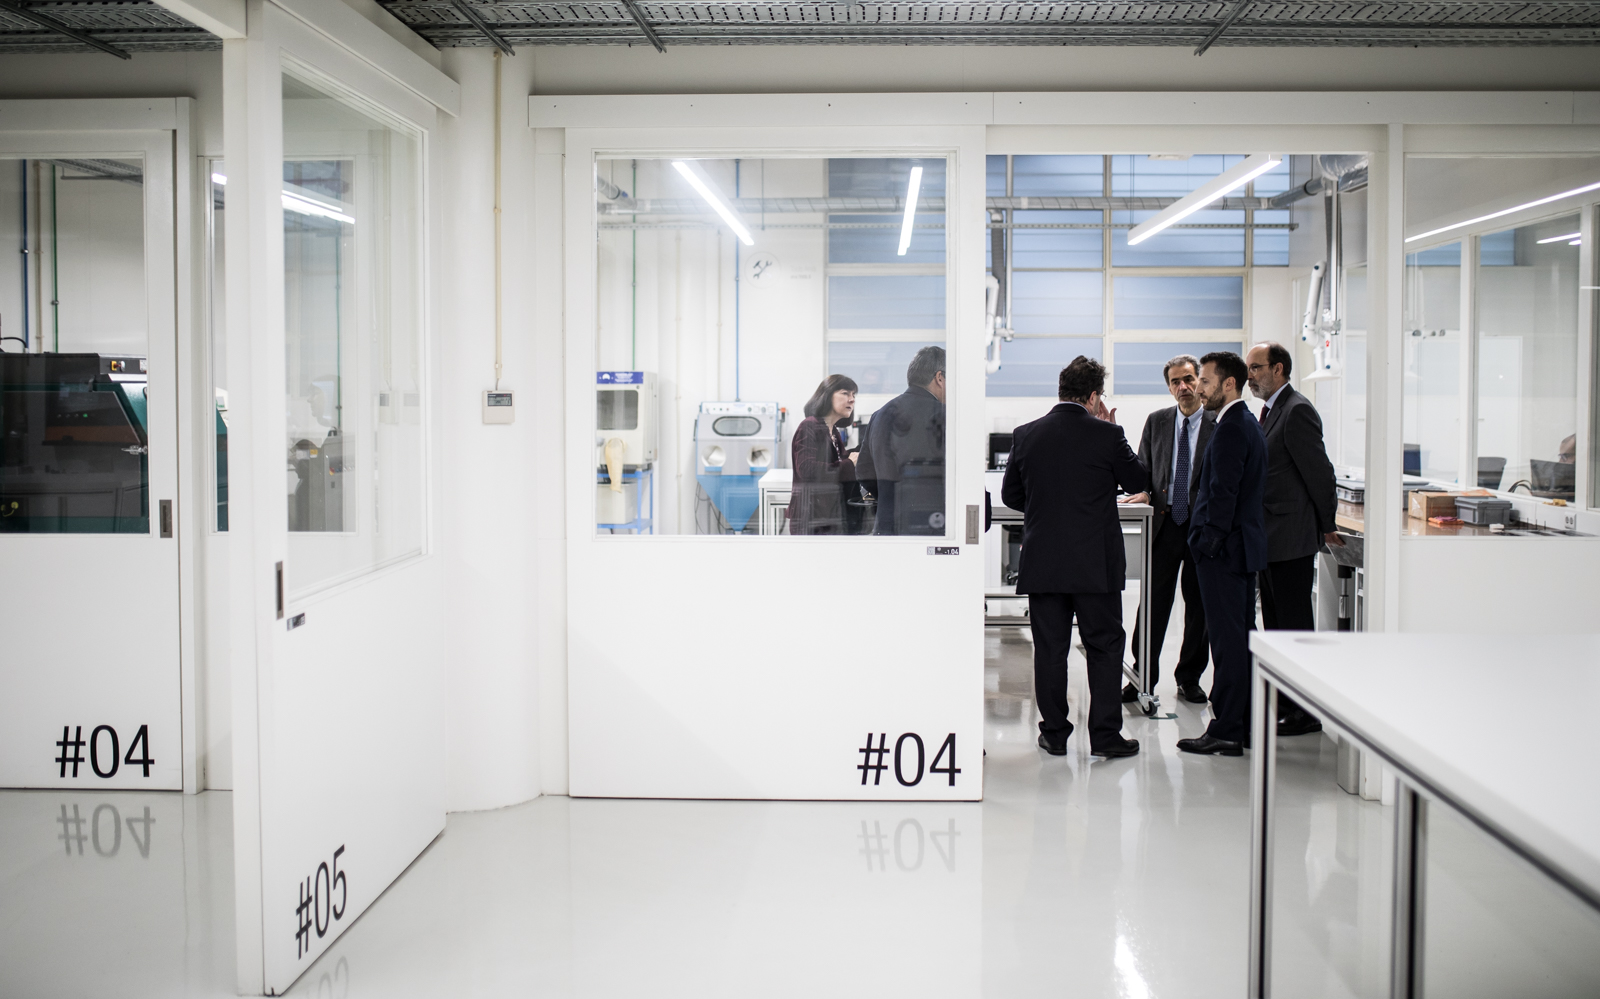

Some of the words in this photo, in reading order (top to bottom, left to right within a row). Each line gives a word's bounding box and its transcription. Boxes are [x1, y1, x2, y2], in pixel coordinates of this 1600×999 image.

[55, 724, 156, 779] #04
[857, 732, 962, 787] #04
[295, 843, 347, 960] #05
